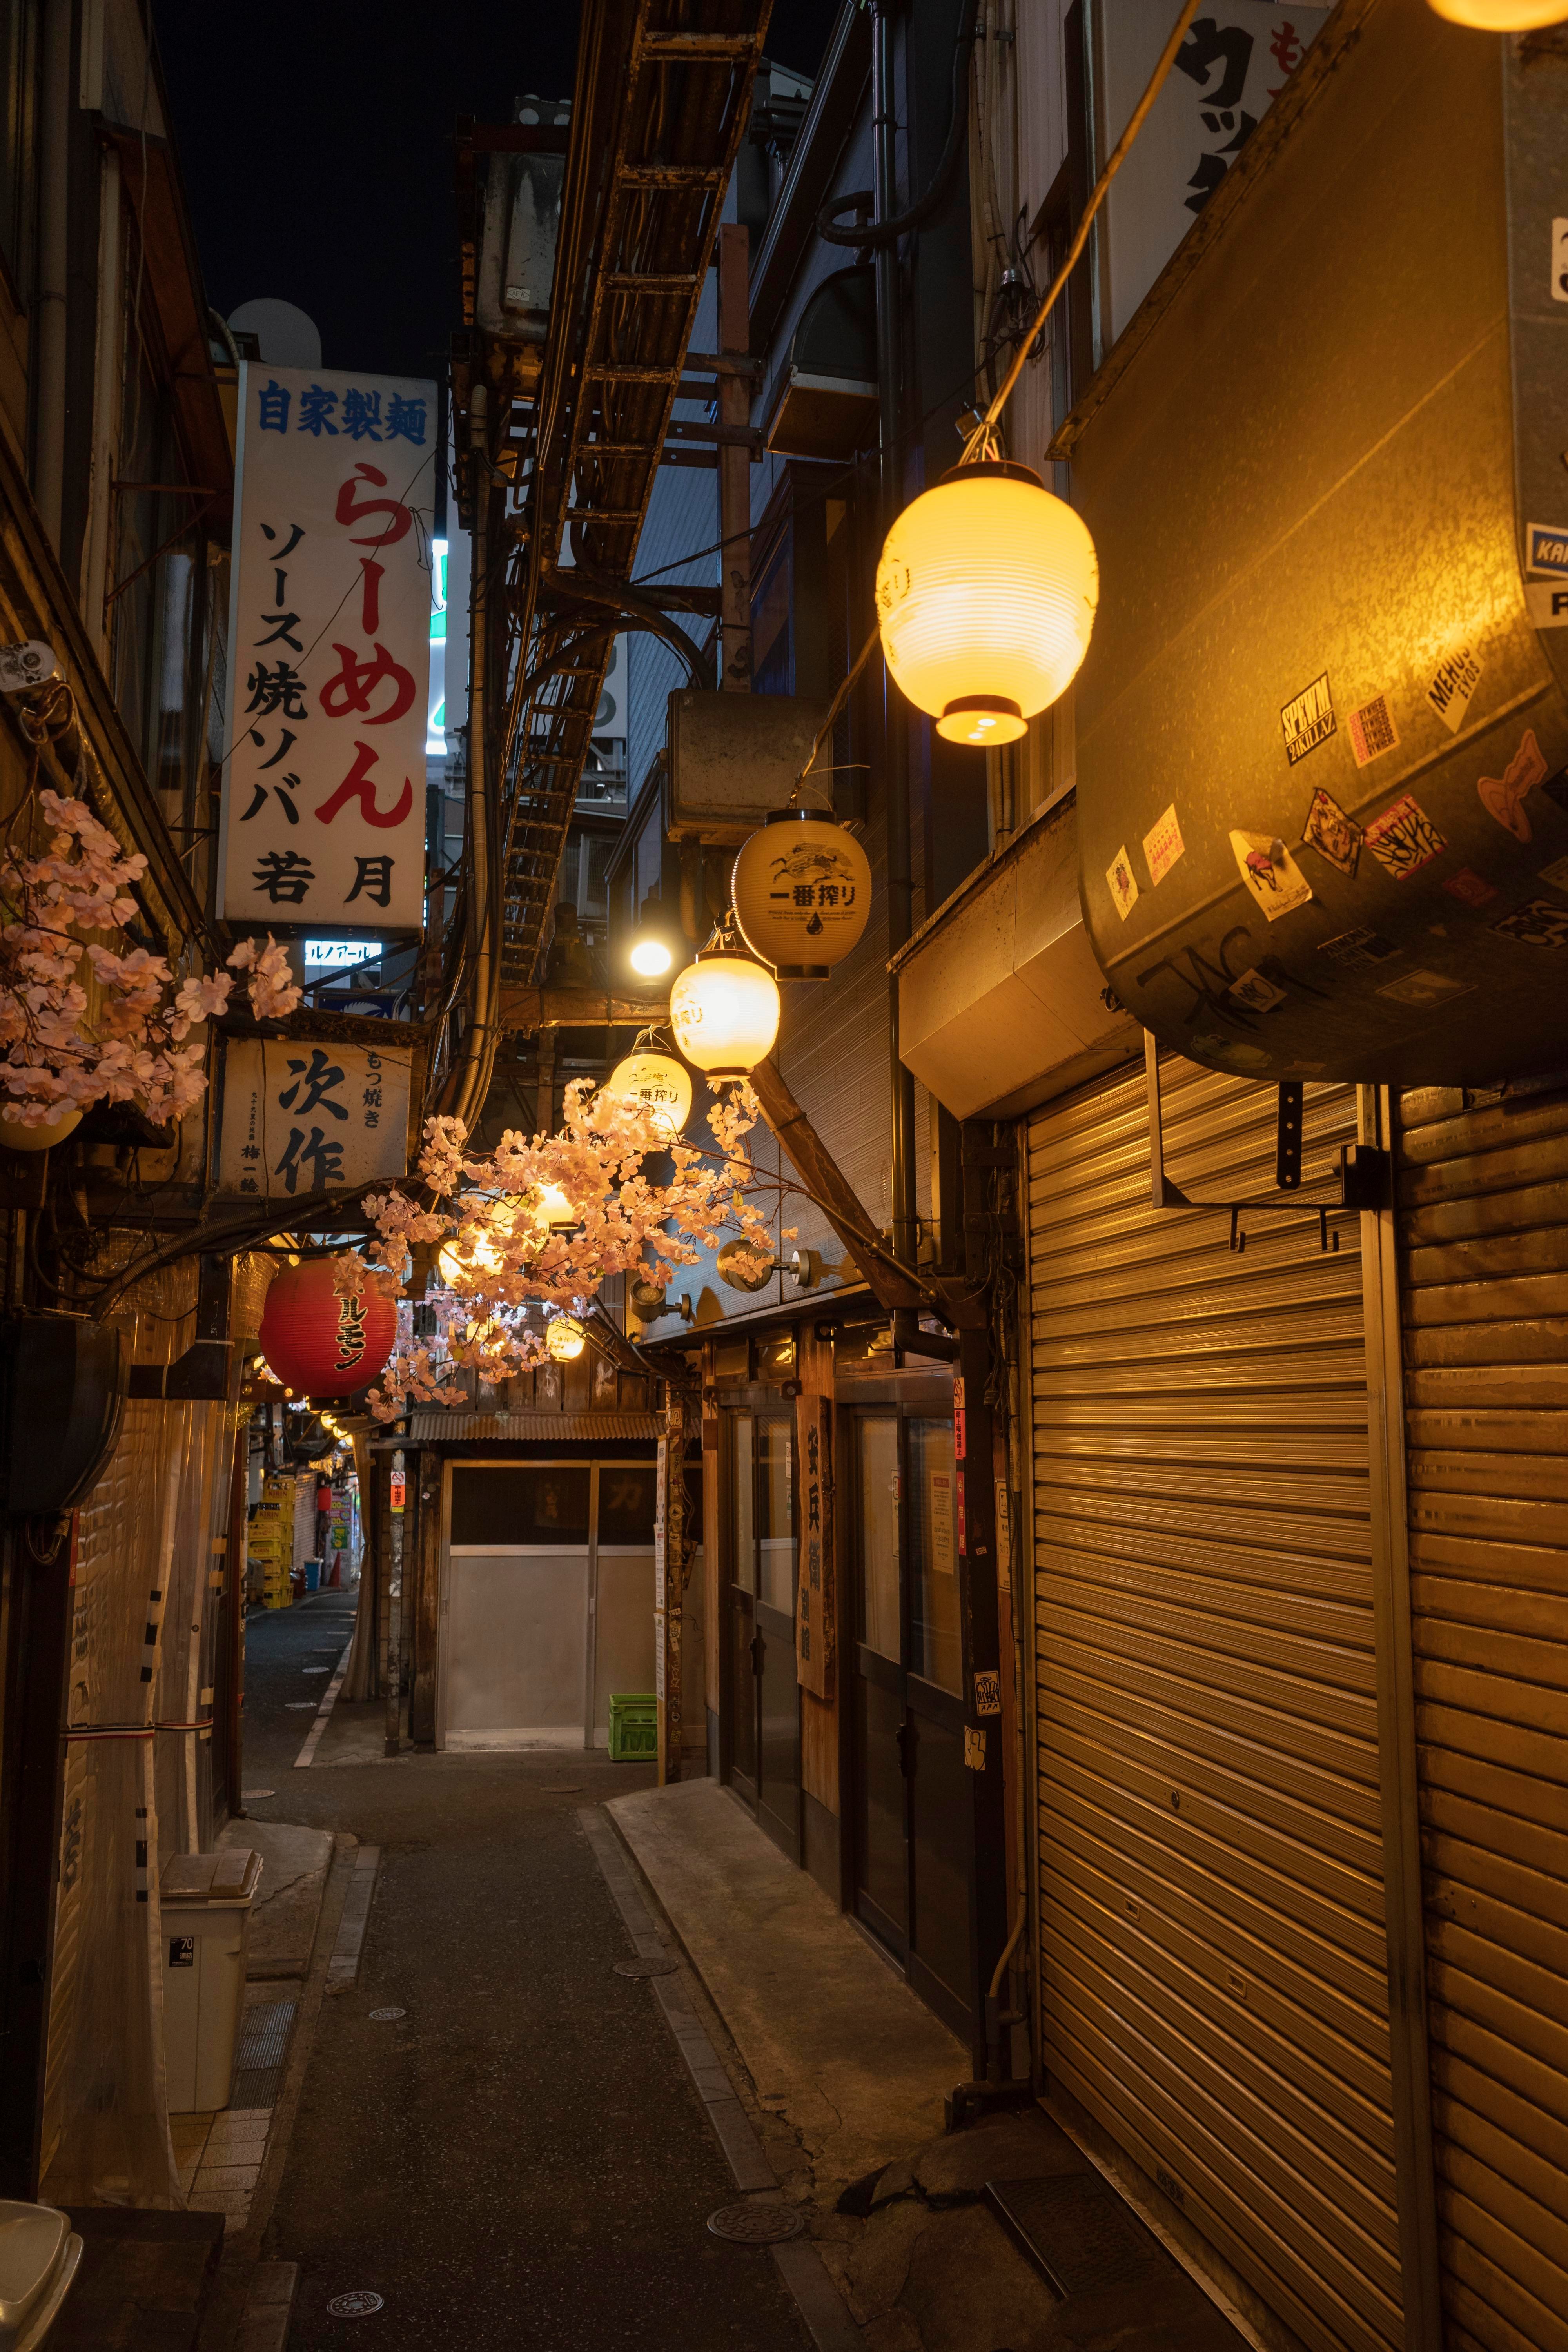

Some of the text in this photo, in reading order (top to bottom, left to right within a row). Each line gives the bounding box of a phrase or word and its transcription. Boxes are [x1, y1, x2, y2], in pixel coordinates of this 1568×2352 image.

[258, 379, 427, 446] 自家製麺
[239, 523, 309, 826] ソース焼ソバ
[314, 461, 416, 829] らーめん
[769, 884, 856, 907] 一番搾り
[311, 945, 370, 960] ルノアール
[274, 1048, 349, 1194] 次作
[363, 1051, 382, 1129] もつ焼き
[628, 1088, 678, 1103] 一番搾り
[240, 1145, 260, 1193] 梅一輪
[333, 1279, 368, 1371] ルモン
[181, 1938, 193, 1950] 70
